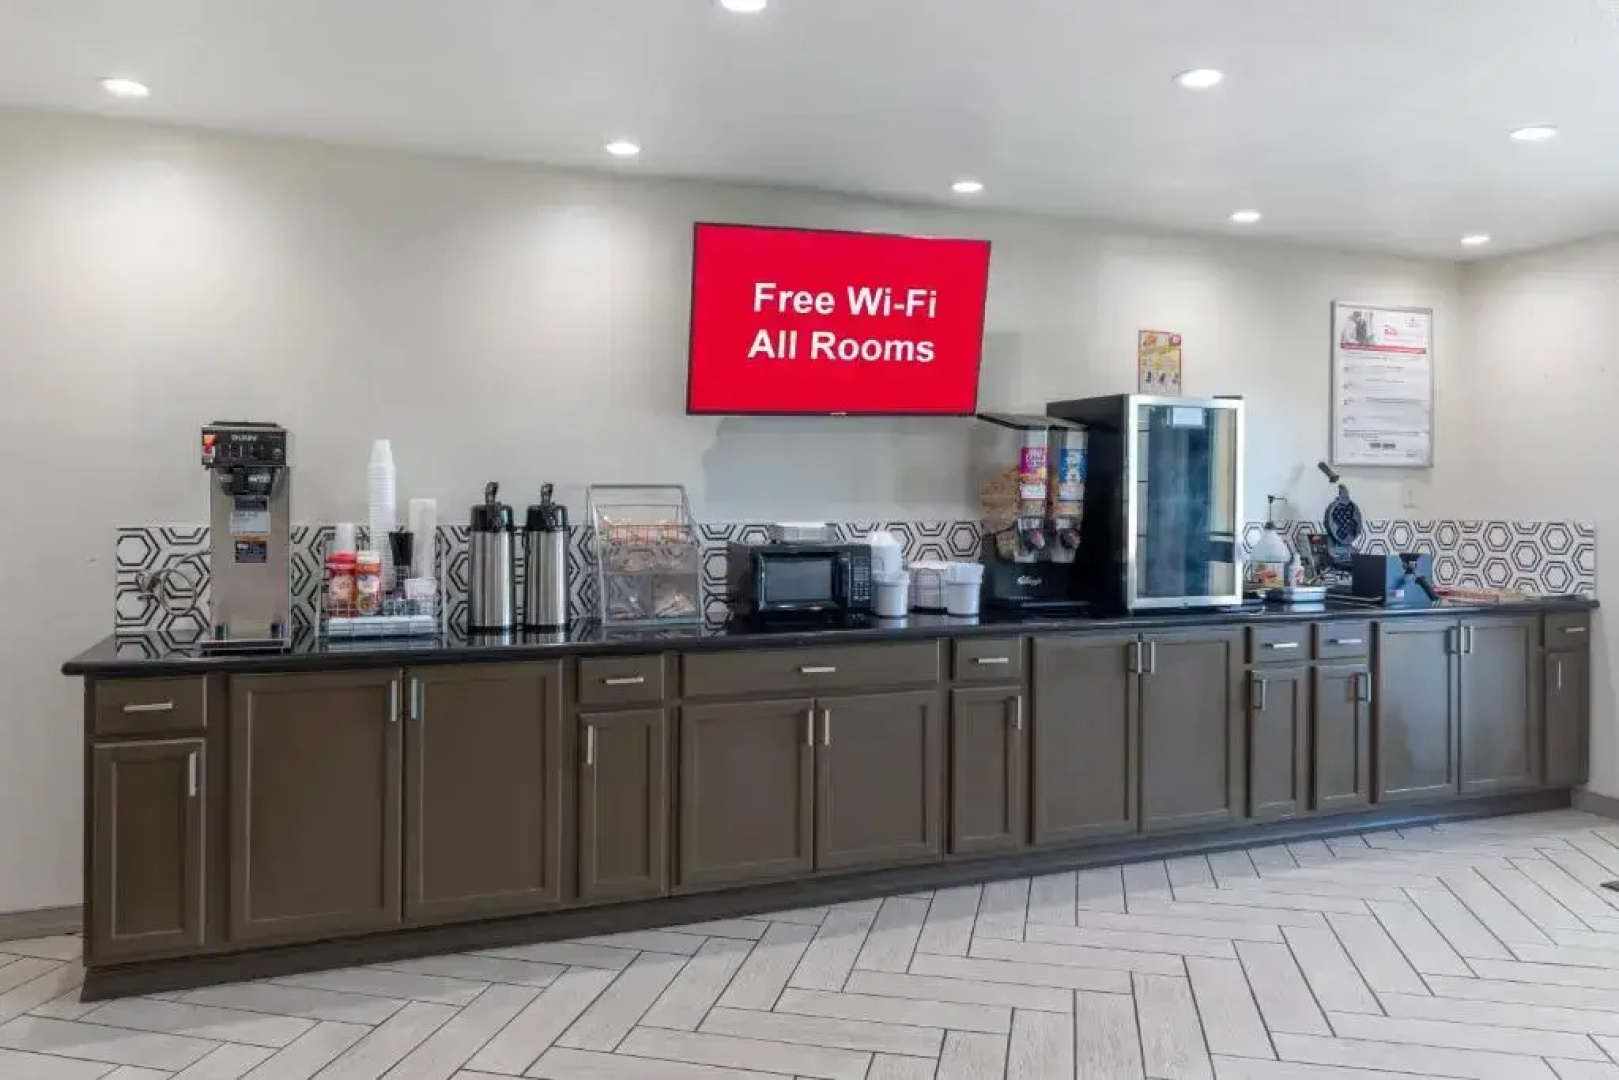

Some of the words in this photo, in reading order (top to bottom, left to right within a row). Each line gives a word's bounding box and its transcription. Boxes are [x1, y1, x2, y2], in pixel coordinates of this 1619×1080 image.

[753, 282, 836, 315] Free
[847, 286, 937, 318] Wi-Fi
[747, 328, 798, 360] All
[810, 331, 935, 363] Rooms
